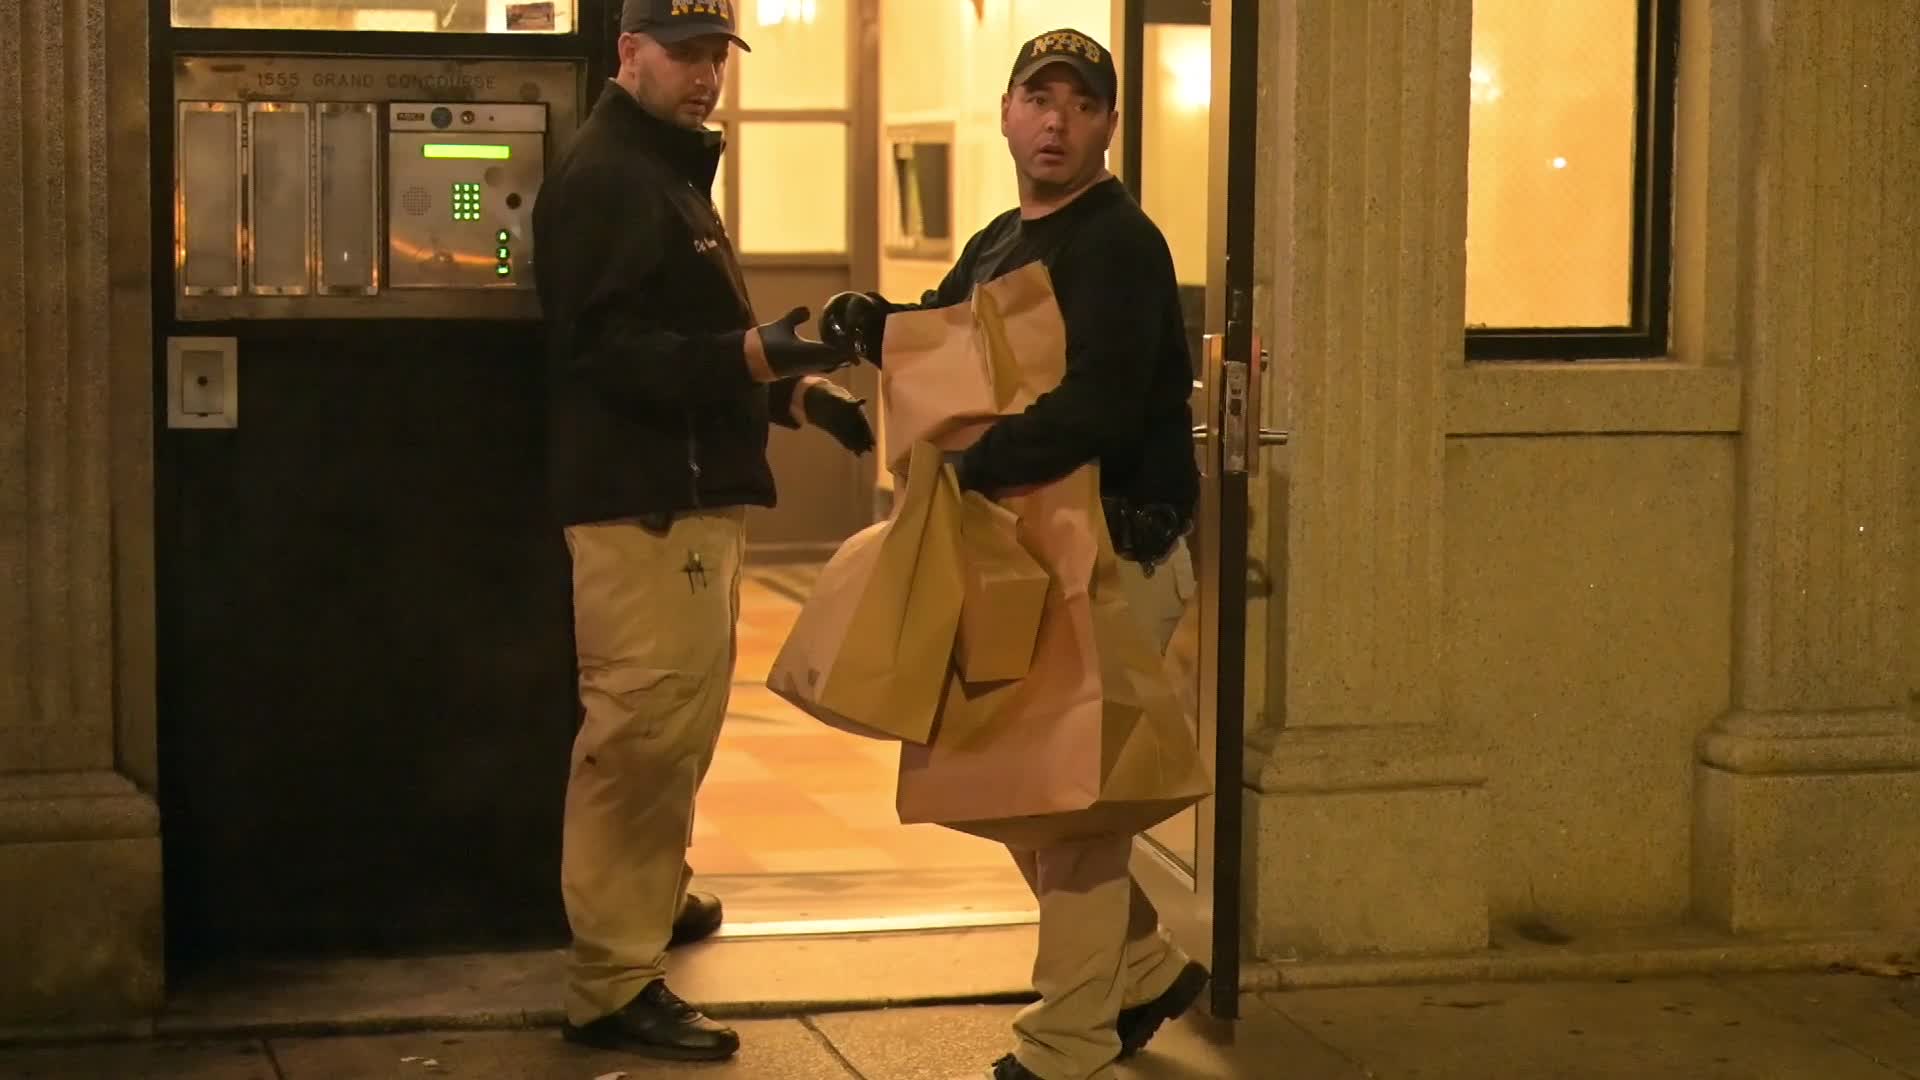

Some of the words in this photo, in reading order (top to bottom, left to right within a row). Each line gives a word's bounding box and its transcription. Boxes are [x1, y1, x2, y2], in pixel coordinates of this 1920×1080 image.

[1030, 32, 1100, 63] NYPD
[257, 72, 300, 87] 1555
[312, 73, 375, 88] GRAND
[385, 73, 497, 89] CONCOURSE
